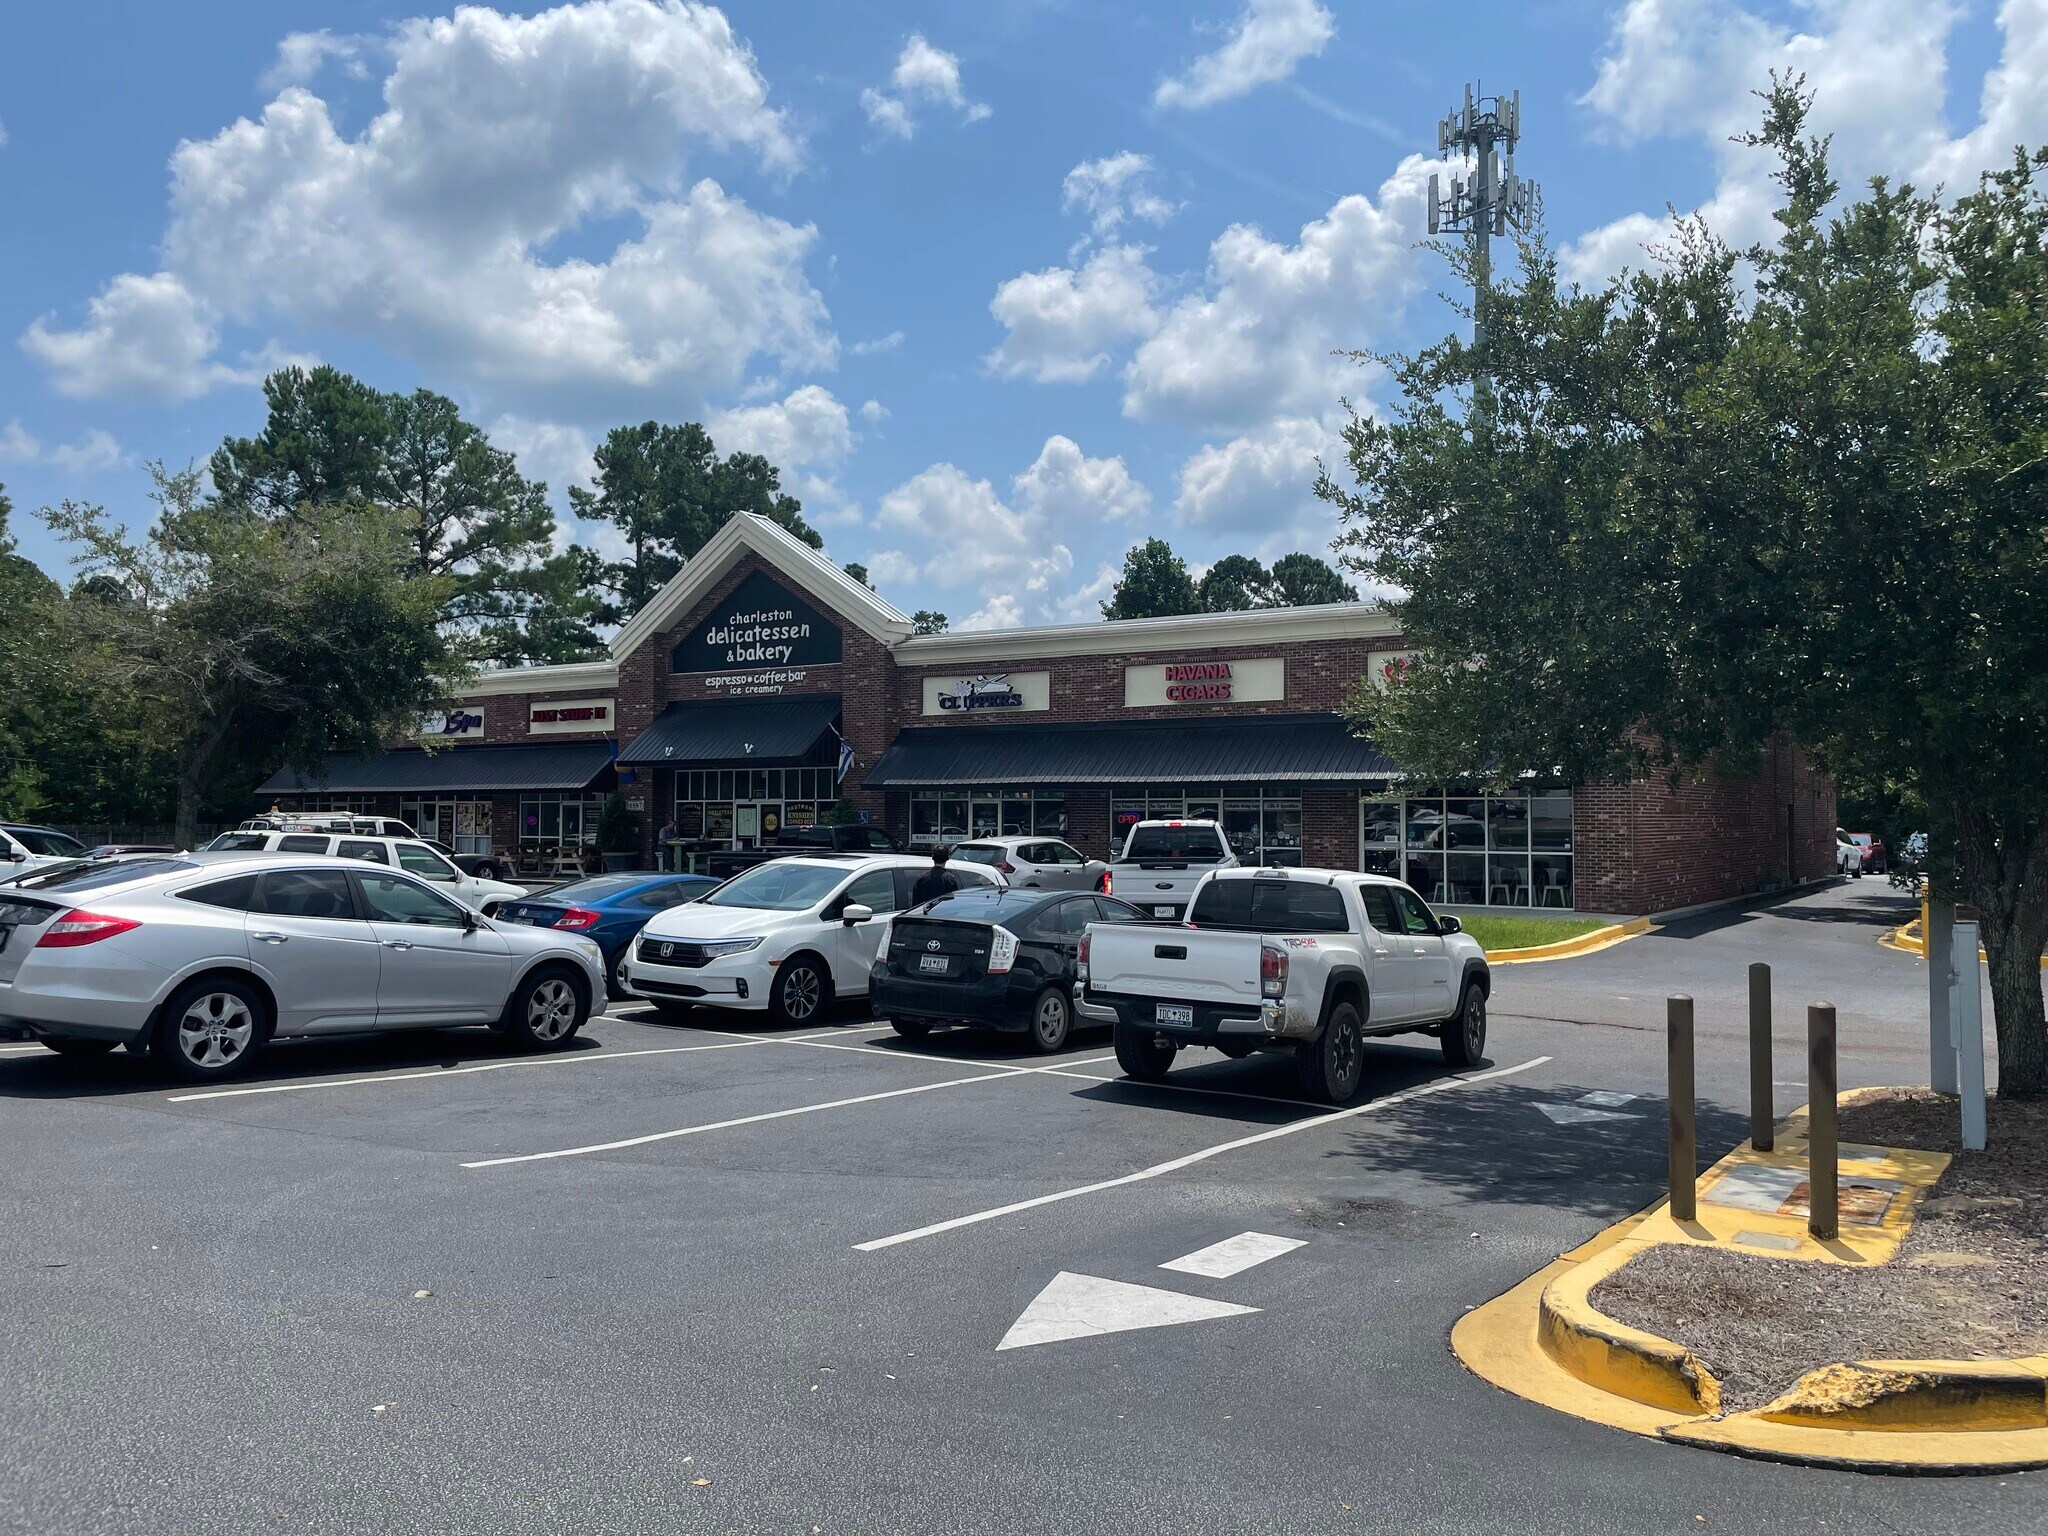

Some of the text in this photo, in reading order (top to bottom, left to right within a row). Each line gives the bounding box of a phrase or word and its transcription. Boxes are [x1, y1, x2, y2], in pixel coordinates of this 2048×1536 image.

[729, 609, 793, 625] charleston
[706, 623, 810, 645] delicatessen
[726, 642, 793, 663] & bakery
[705, 670, 807, 689] espresso coffee bar
[1165, 664, 1232, 682] HAVANA
[730, 684, 784, 695] ice creamery
[1165, 684, 1232, 701] CIGARS
[443, 711, 482, 734] Spa
[531, 706, 607, 723] JUST STUFF IT
[787, 811, 815, 819] KNISHES
[1117, 814, 1140, 824] OPEN
[1177, 1010, 1190, 1020] 398
